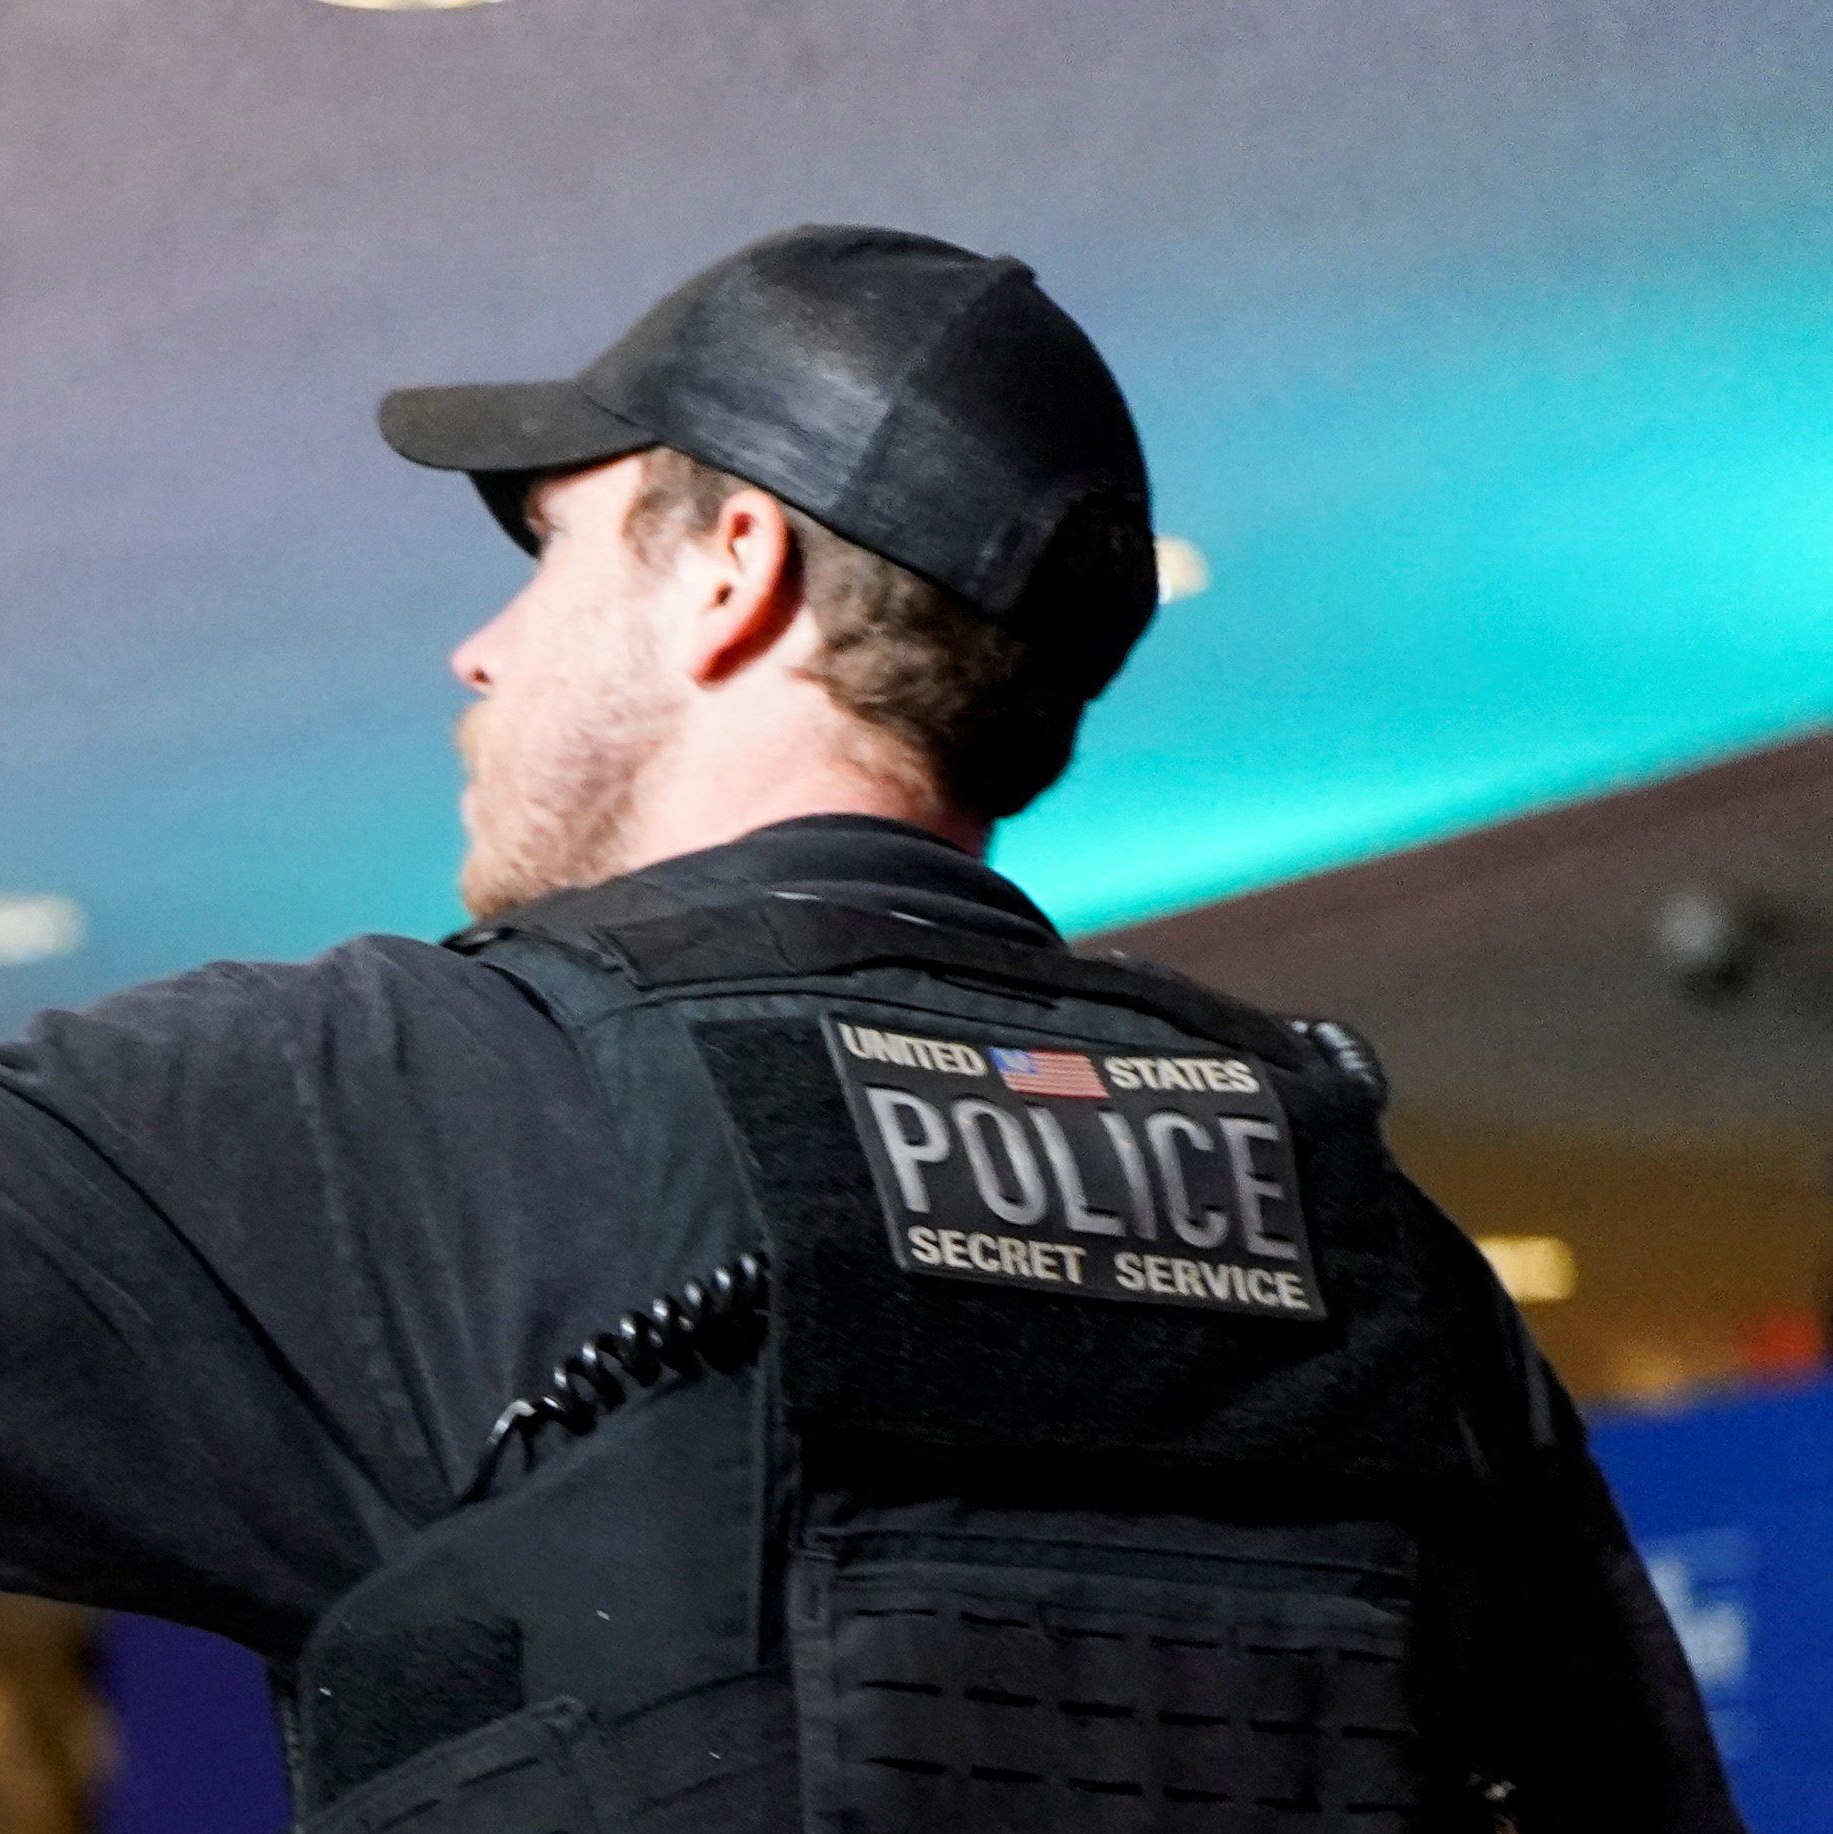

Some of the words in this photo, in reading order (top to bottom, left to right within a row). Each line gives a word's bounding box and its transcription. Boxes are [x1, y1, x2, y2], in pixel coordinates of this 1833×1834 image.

[839, 1024, 988, 1076] UNITED
[1105, 1058, 1259, 1093] STATES
[866, 1086, 1299, 1259] POLICE
[909, 1227, 1086, 1283] SECRET
[1116, 1254, 1310, 1309] SERVICE
